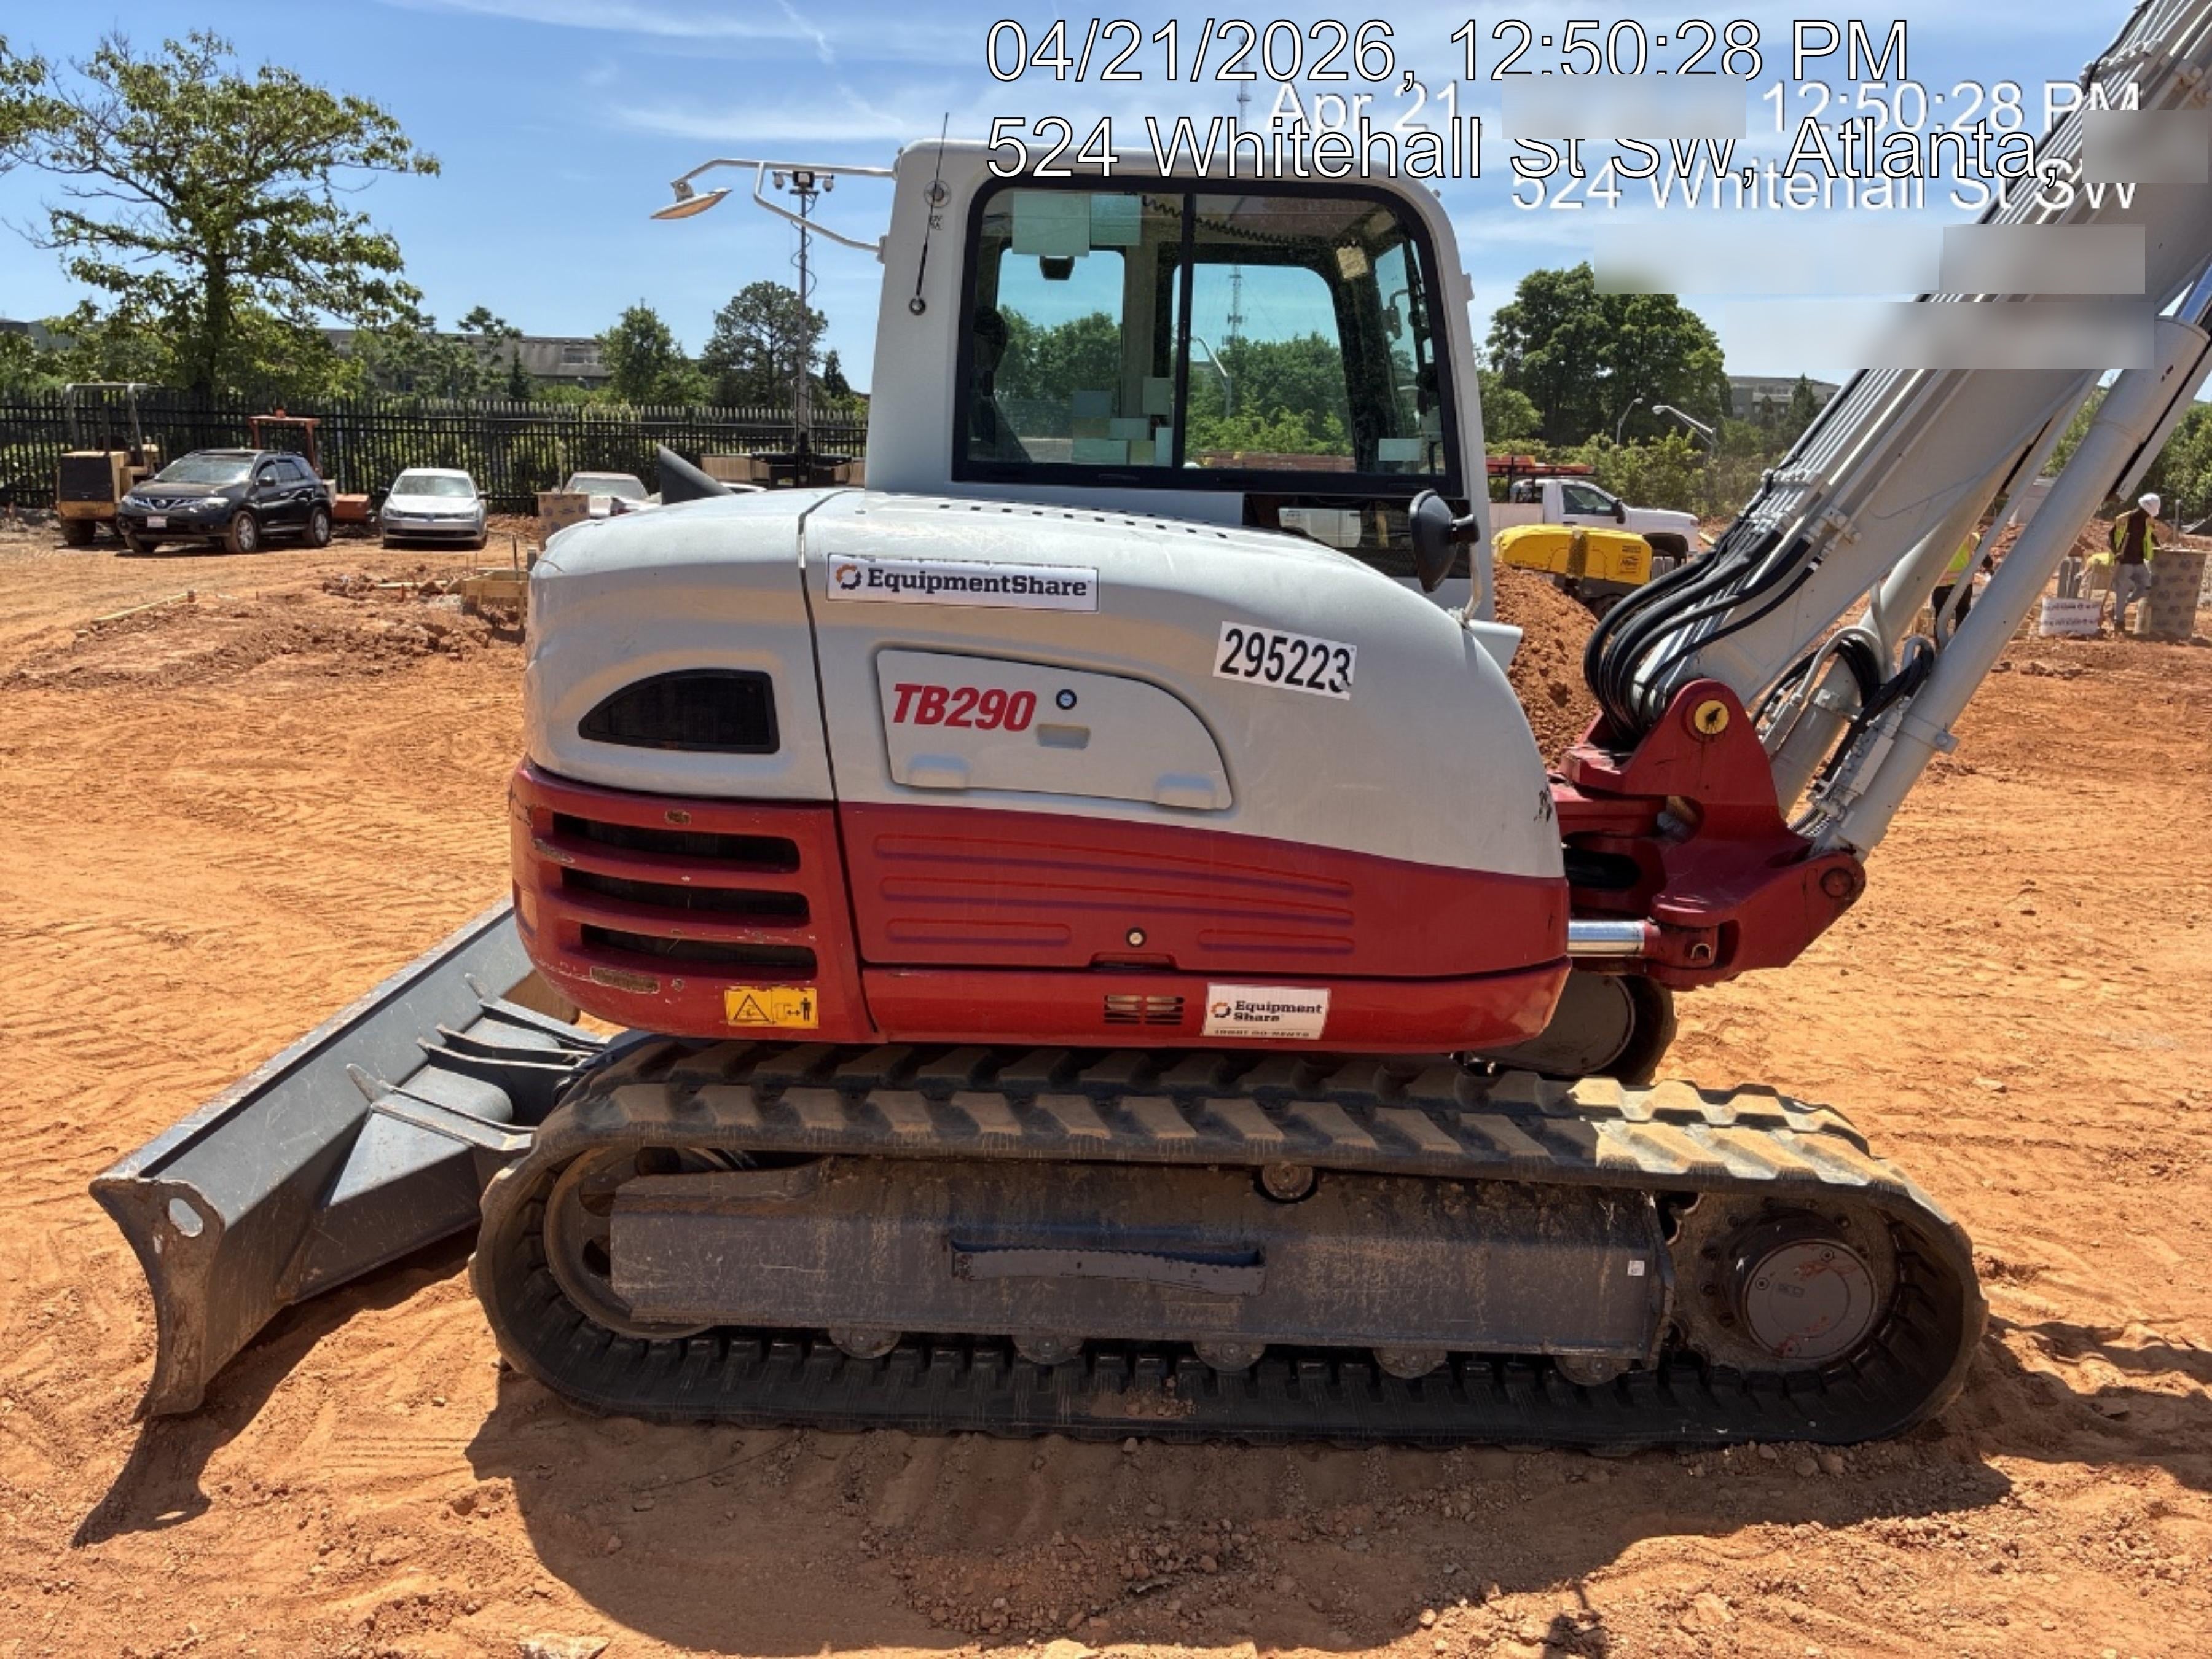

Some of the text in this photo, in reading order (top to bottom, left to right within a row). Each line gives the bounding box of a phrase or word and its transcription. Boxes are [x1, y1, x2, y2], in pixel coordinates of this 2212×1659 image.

[867, 567, 1088, 597] EquipmentShare
[1220, 627, 1352, 694] 295223
[893, 683, 1037, 732] TB290
[1233, 1011, 1281, 1022] Share
[1234, 1000, 1323, 1014] Equipment
